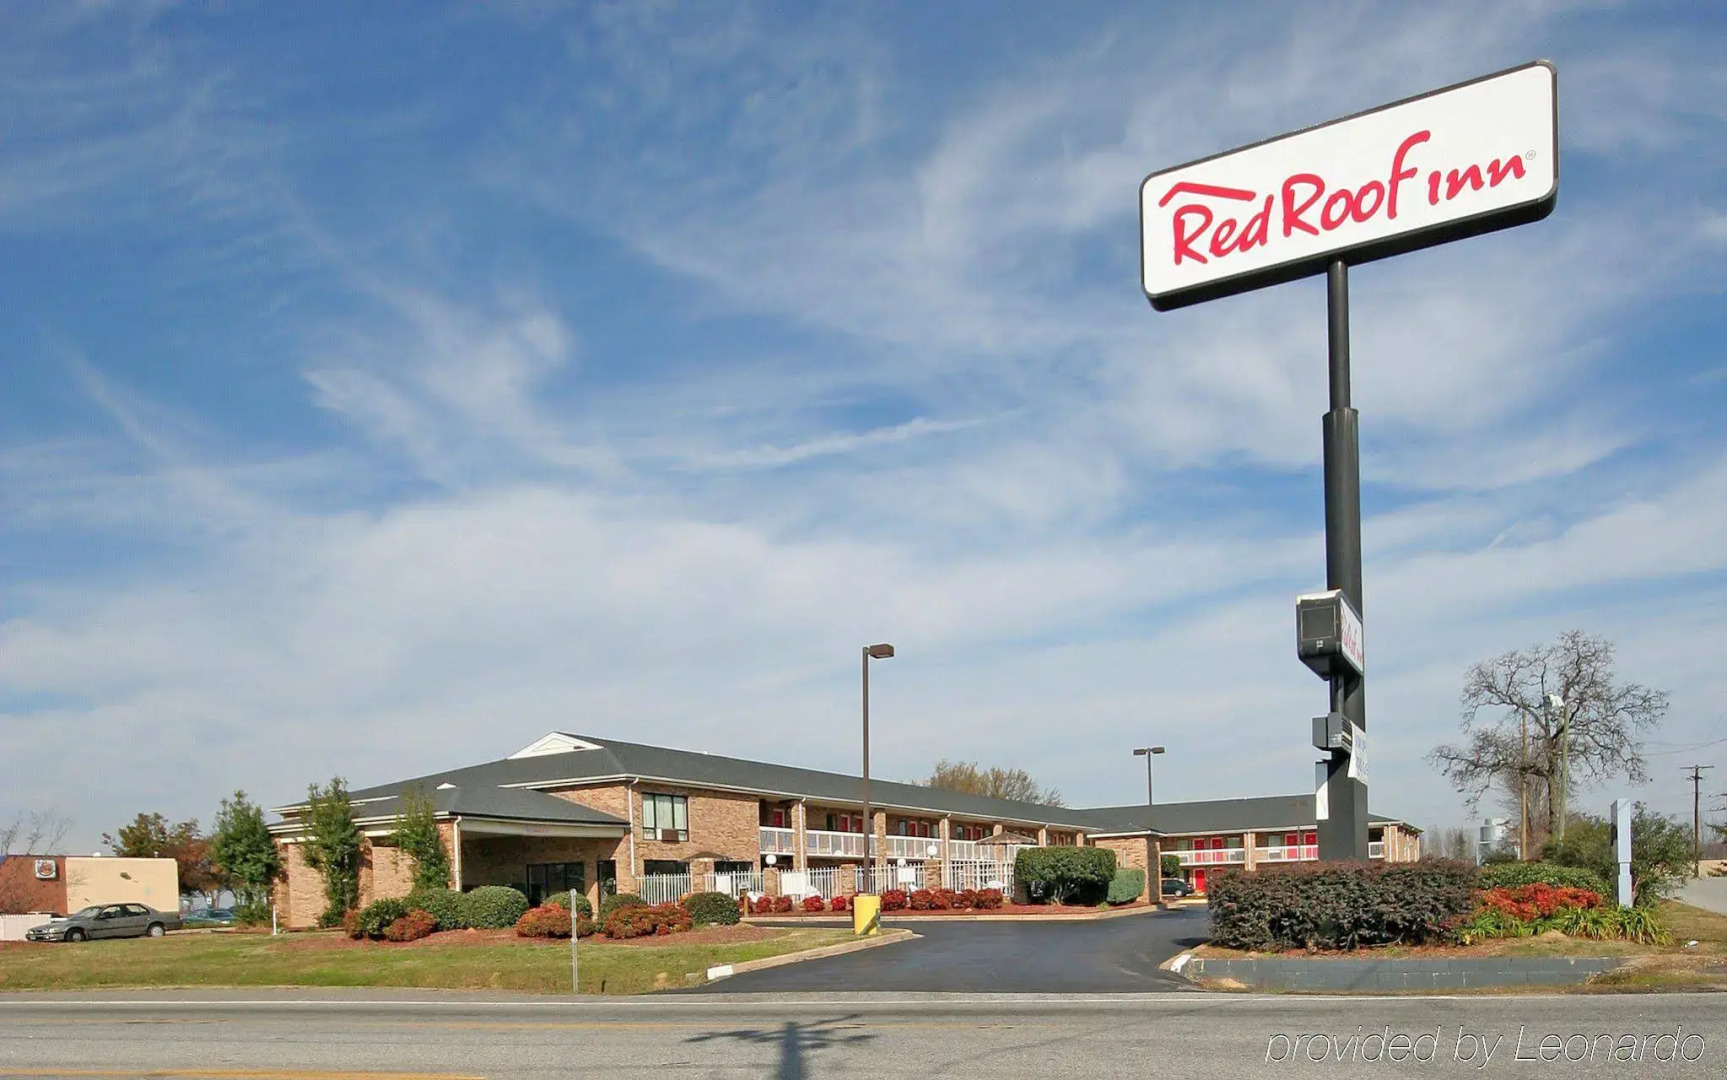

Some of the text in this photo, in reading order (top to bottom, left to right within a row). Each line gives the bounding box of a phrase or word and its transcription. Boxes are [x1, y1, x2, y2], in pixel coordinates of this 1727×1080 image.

[1173, 130, 1526, 265] Red Roof inn
